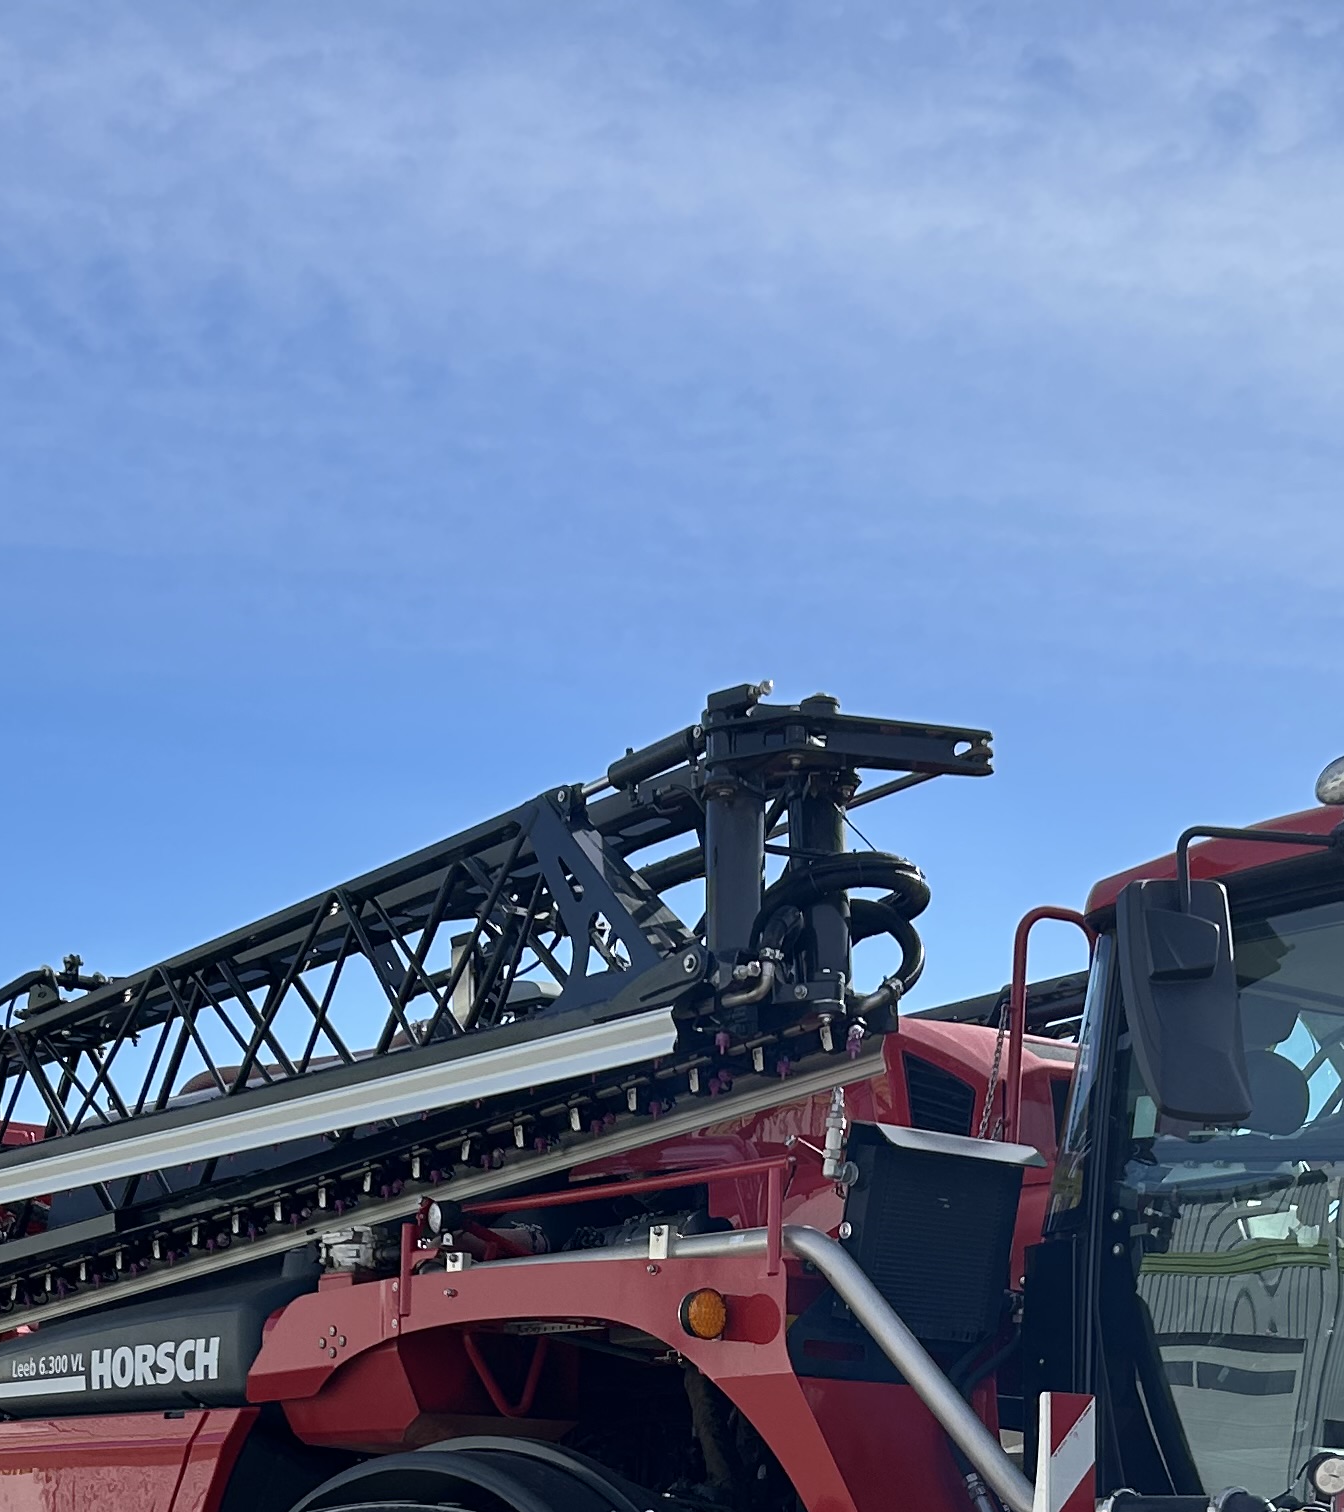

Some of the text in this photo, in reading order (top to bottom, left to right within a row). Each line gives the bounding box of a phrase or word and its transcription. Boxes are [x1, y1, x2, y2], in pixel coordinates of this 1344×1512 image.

[11, 1352, 86, 1378] Leeb 6.300 VL
[90, 1336, 221, 1390] HORSCH
